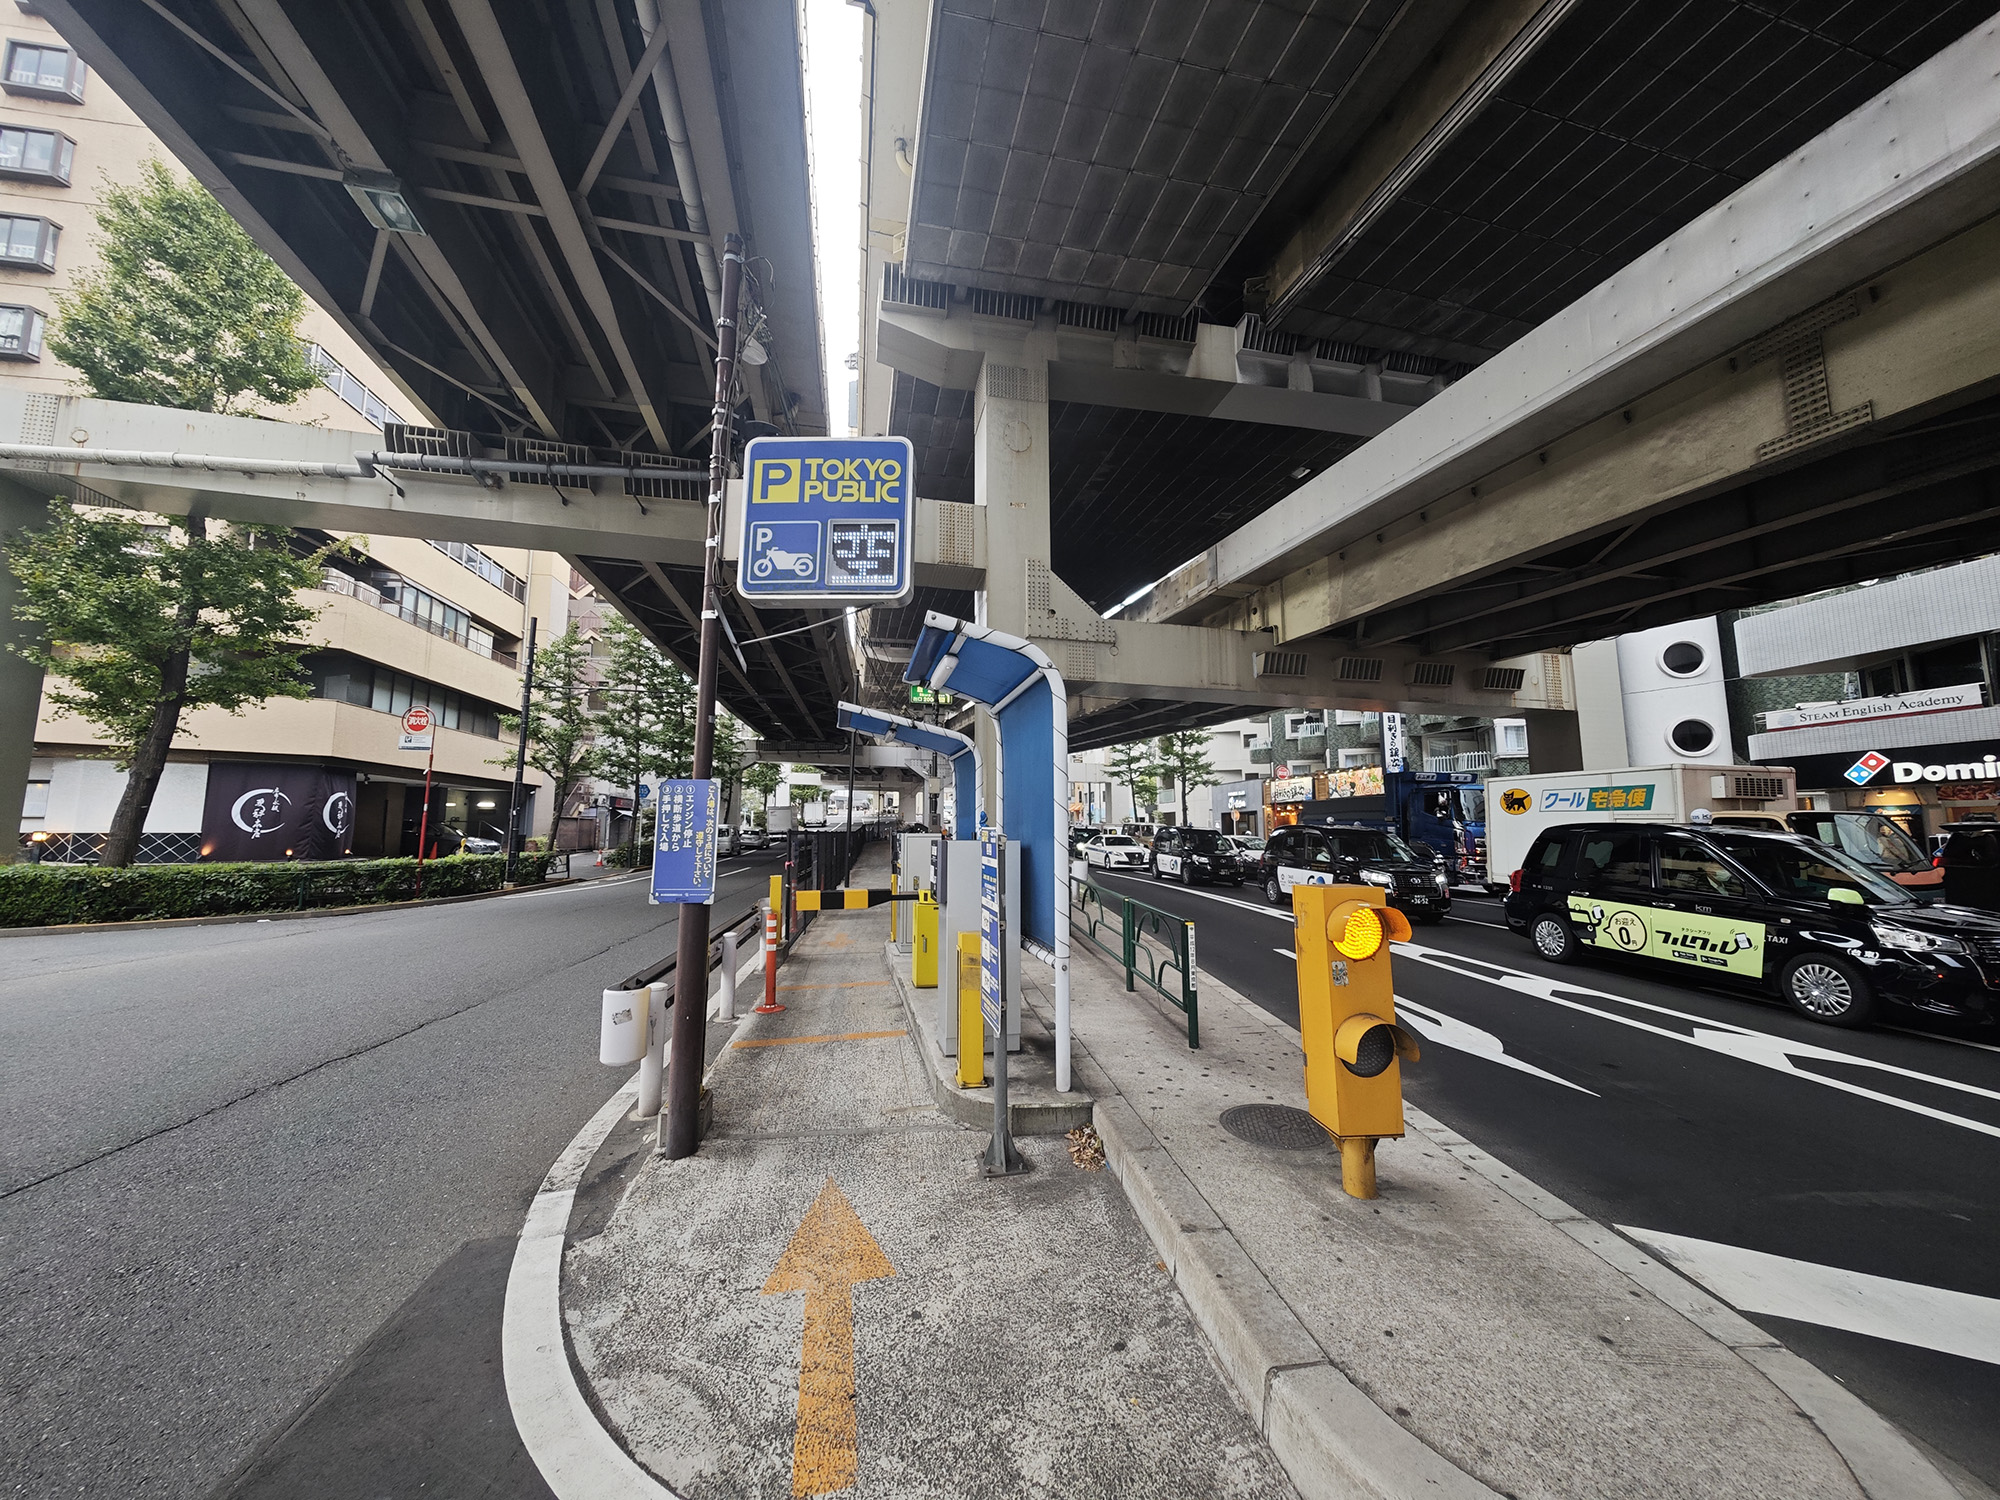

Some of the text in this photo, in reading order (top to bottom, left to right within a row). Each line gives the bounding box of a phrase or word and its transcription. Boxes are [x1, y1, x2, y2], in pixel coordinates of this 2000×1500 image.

[760, 458, 902, 499] P TOKYO
[804, 481, 900, 503] PUBLIC
[756, 527, 773, 551] P
[832, 524, 894, 584] 空
[1842, 703, 1892, 717] English
[1897, 695, 1965, 711] Academy
[1892, 754, 2000, 783] Domi
[1767, 934, 1789, 944] TAXI
